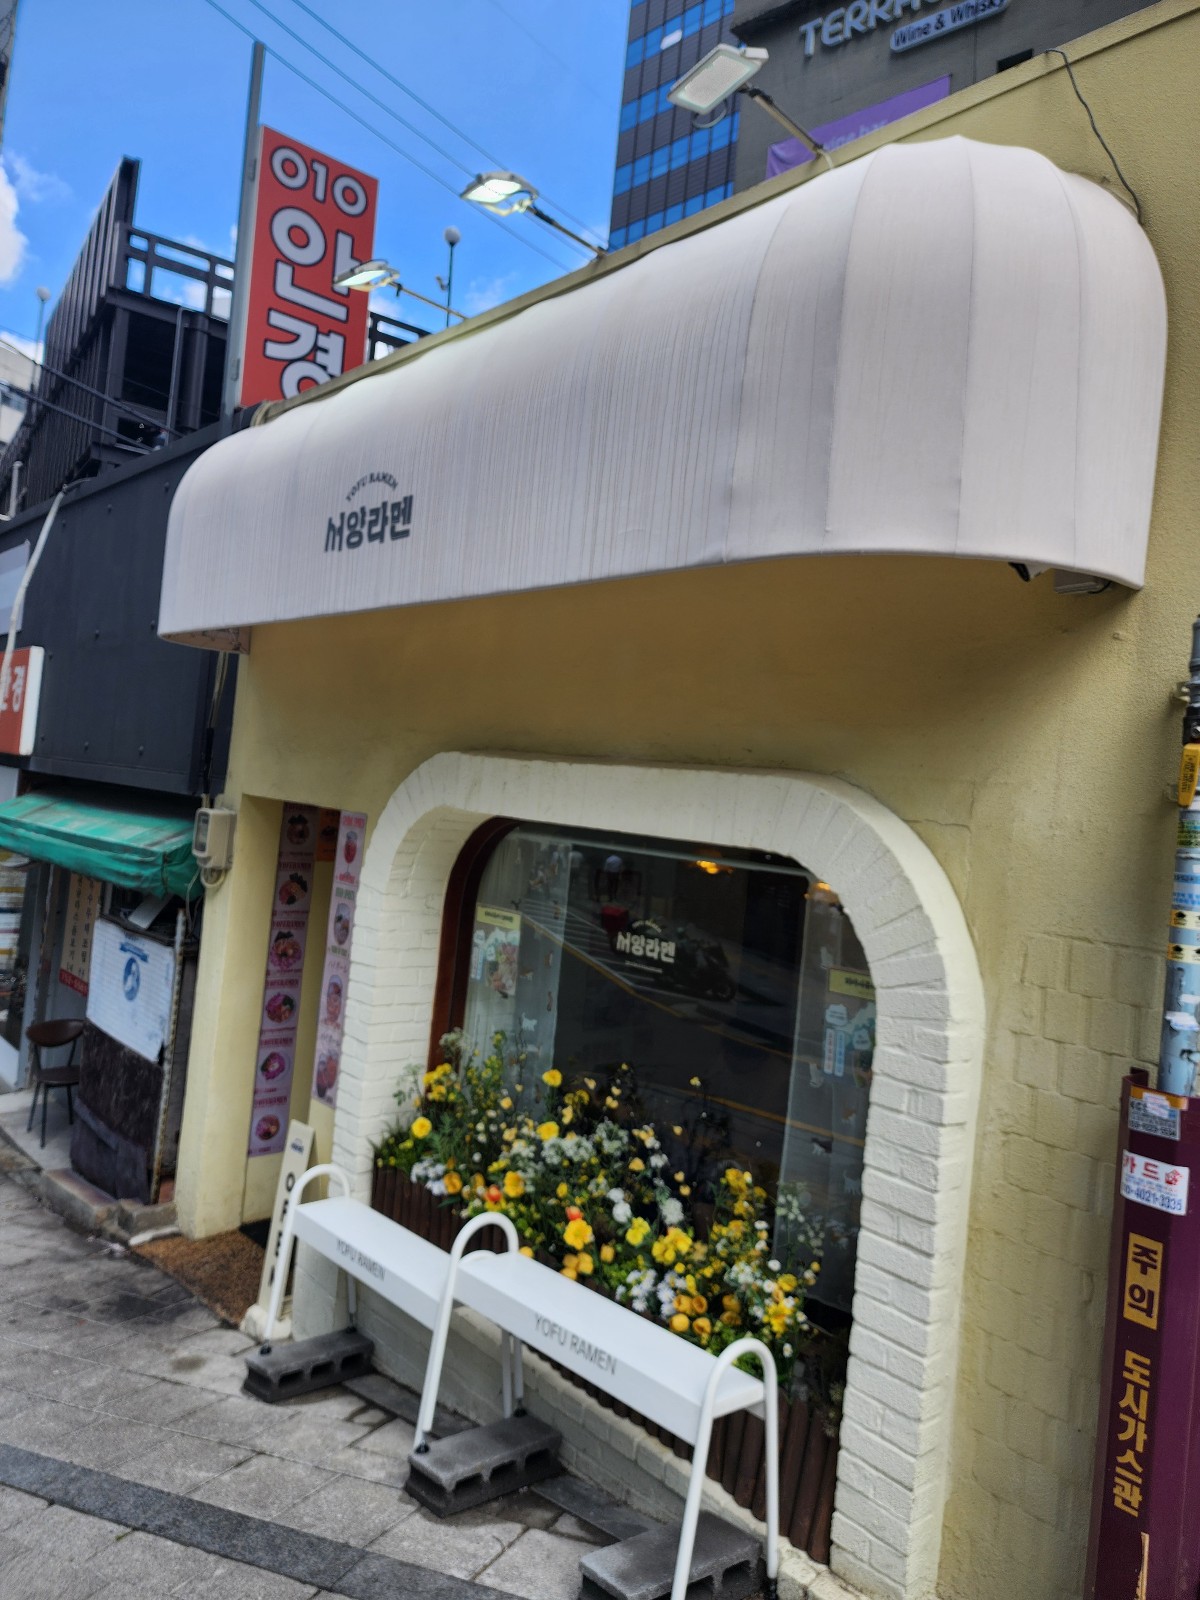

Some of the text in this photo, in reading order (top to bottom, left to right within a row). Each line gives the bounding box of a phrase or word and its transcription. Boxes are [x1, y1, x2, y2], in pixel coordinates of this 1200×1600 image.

[799, 0, 941, 57] TERRA
[895, 21, 931, 47] Wine
[934, 14, 945, 30] &
[270, 145, 368, 217] 010
[263, 206, 364, 400] 안경
[369, 471, 398, 491] RAMEN
[324, 494, 414, 553] 서양라멘
[616, 931, 676, 964] 서양라멘
[535, 1312, 617, 1376] YOFU RAMEN
[1112, 1349, 1151, 1518] 도시가스관
